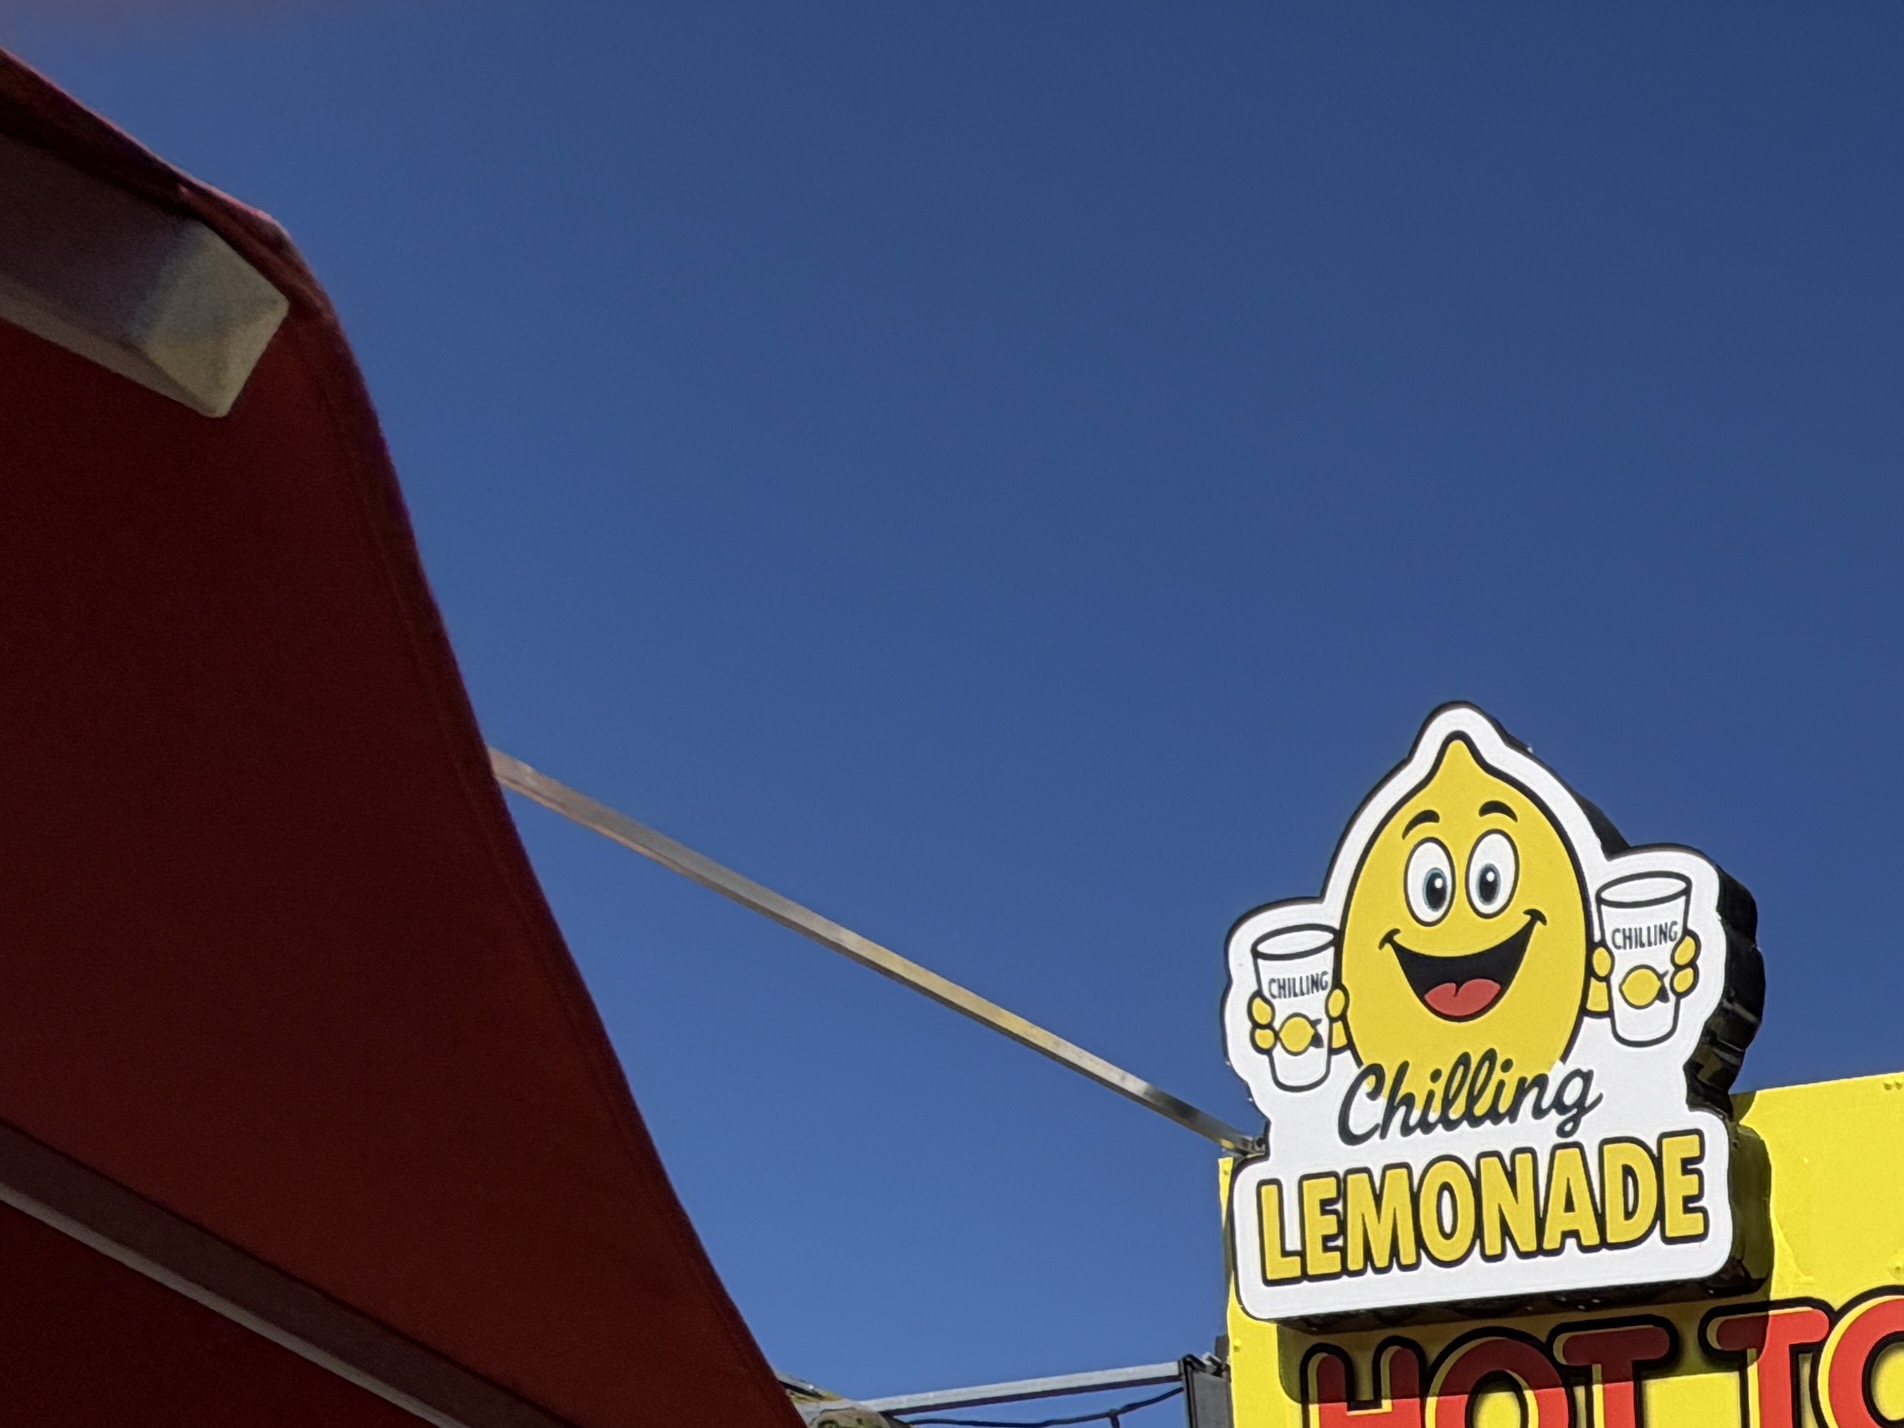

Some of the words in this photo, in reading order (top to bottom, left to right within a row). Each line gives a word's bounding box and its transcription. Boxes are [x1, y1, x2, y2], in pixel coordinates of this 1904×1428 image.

[1612, 920, 1679, 950] CHILLING
[1268, 970, 1329, 1001] CHILLING
[1338, 1048, 1603, 1147] Chilling
[1257, 1129, 1711, 1287] LEMONADE
